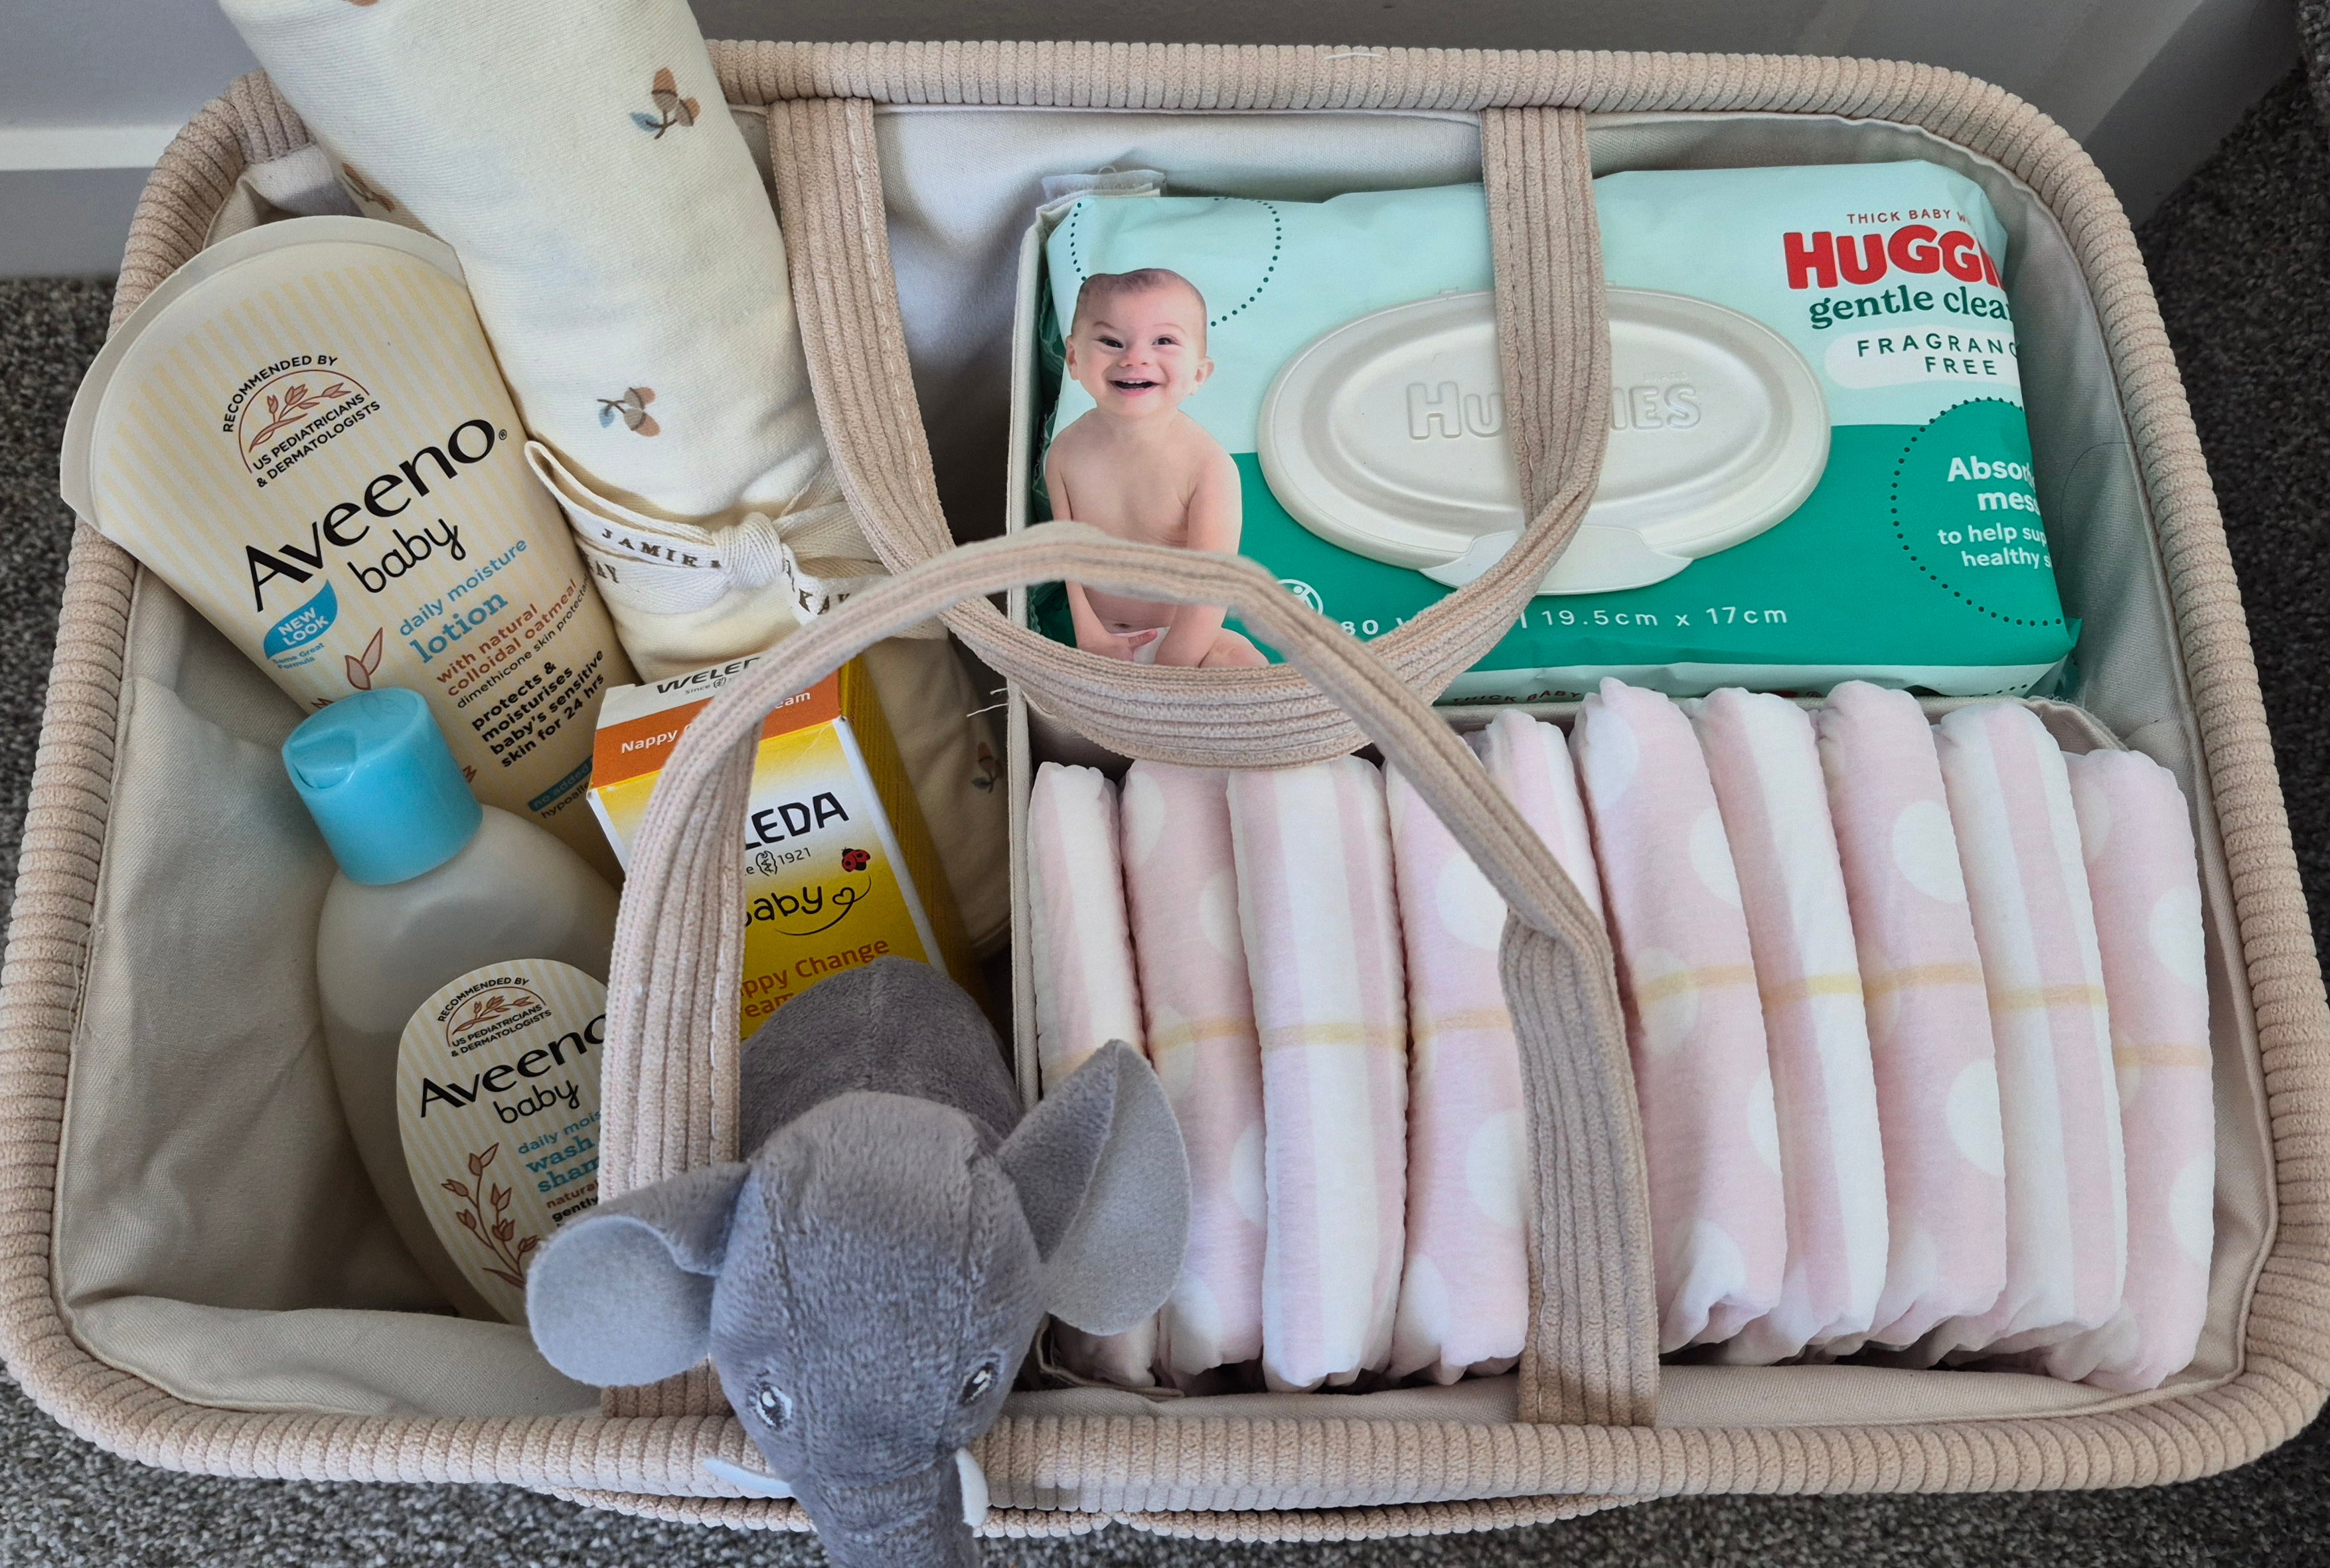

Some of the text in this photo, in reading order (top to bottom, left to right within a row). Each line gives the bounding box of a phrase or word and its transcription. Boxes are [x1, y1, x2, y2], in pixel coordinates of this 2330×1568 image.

[1846, 211, 1901, 225] THICK
[1908, 208, 1951, 221] BABY
[1783, 224, 2007, 291] HUGGI
[1809, 284, 2012, 330] gentle clea
[1924, 356, 1997, 376] FREE
[223, 354, 339, 432] RECOMMENDED BY
[1405, 380, 1701, 441] HUIES
[252, 394, 365, 471] US PEDIATRICIANS
[256, 401, 381, 488] & DERMATOLOGISTS
[601, 528, 698, 568] JAMIE
[1937, 529, 1962, 545] to
[1968, 522, 2017, 544] help
[347, 518, 466, 593] baby
[1961, 547, 2040, 570] healthy
[400, 539, 527, 637] daily moisture
[277, 607, 316, 635] NEW
[282, 615, 329, 646] LOOK
[410, 593, 508, 664] lotion
[448, 578, 576, 697] colloidal oatmeal
[1341, 621, 1379, 636] 80
[1541, 606, 1788, 627] 19.5cm x 17cm
[277, 657, 315, 669] Formula
[299, 643, 325, 657] Great
[437, 603, 538, 684] with natural
[457, 651, 532, 709] dimethicone
[533, 630, 556, 653] skin
[657, 657, 761, 694] WELE
[685, 684, 710, 695] Since
[471, 662, 557, 732] protects &
[481, 666, 573, 742] moisturises
[490, 650, 603, 755] baby's sensitive
[1452, 690, 1581, 703] THICK BABY
[501, 673, 604, 768] skin for 24 hrs
[621, 730, 678, 753] Nappy
[554, 763, 589, 796] added
[777, 848, 811, 865] 1921
[741, 940, 890, 998] ppy Change
[437, 977, 529, 1022] RECOMMENDED BY
[452, 1004, 542, 1047] US PEDIATRICIANS
[460, 1010, 552, 1054] DERMATOLOGISTS
[493, 1080, 580, 1124] baby
[518, 1111, 601, 1154] daily mois
[525, 1135, 595, 1173] wash
[552, 1196, 599, 1222] gently
